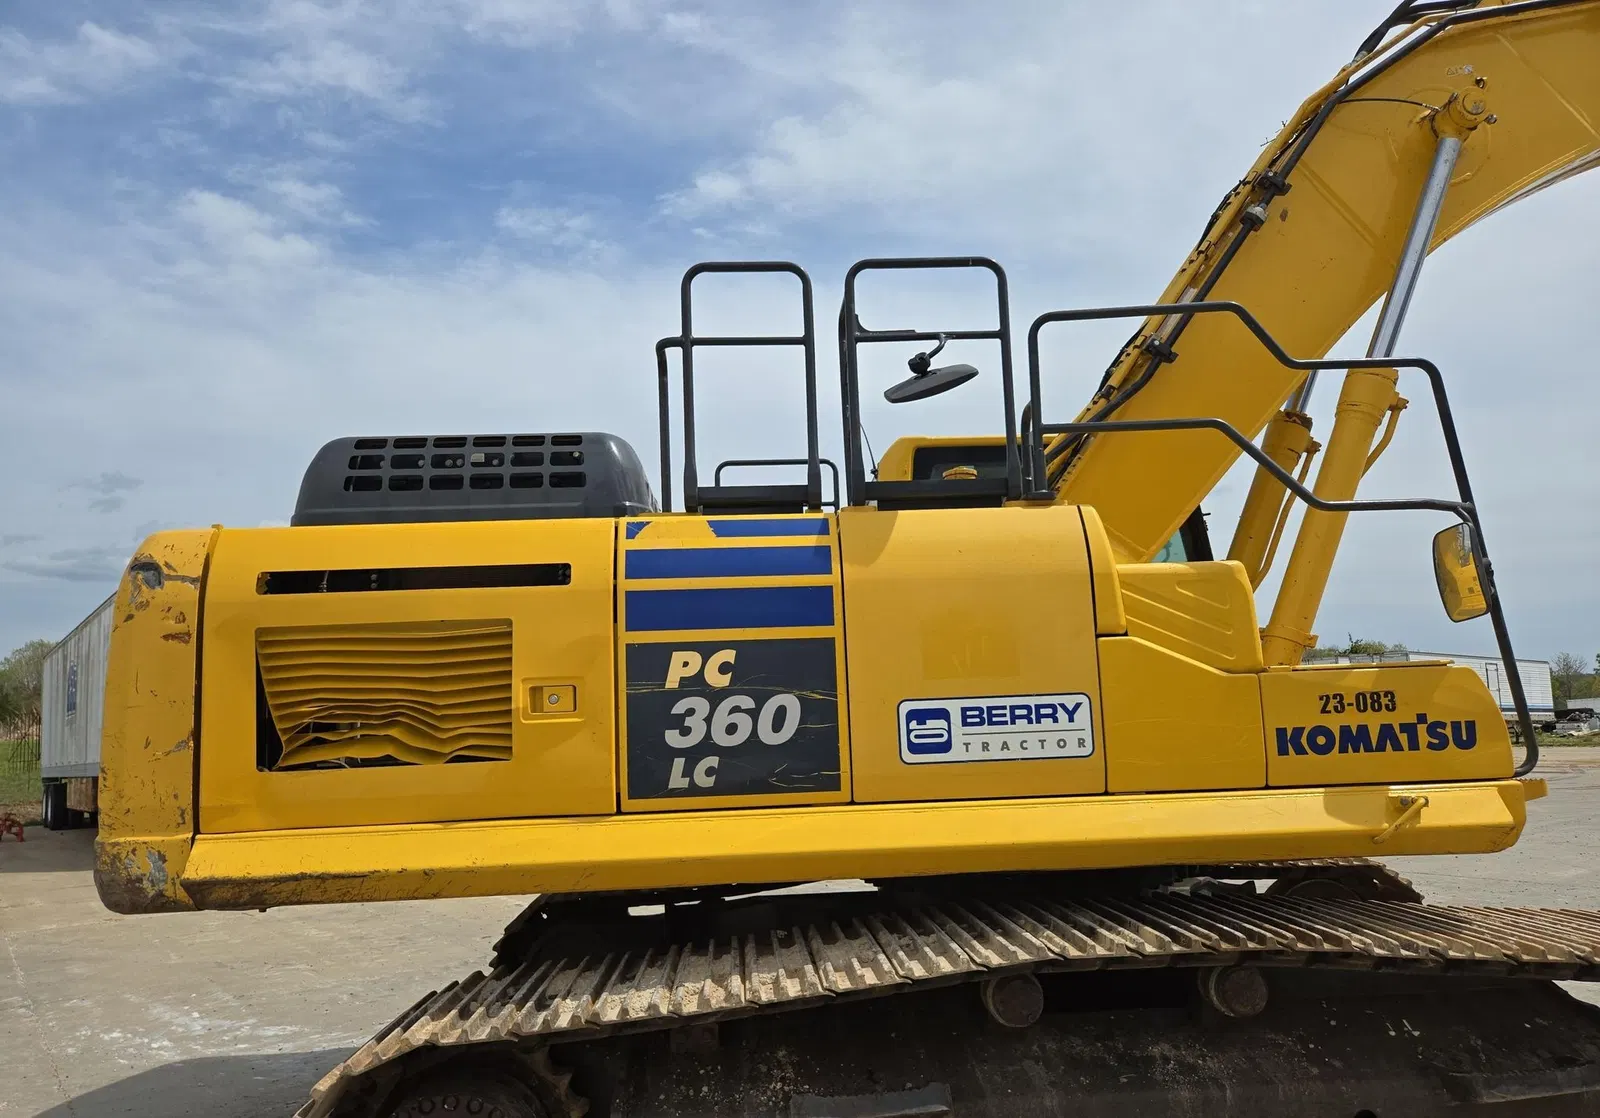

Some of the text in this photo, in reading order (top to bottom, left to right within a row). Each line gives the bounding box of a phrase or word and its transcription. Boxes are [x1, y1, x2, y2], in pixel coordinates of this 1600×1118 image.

[665, 649, 736, 689] PC
[960, 702, 1083, 727] BERRY
[1319, 690, 1397, 714] 23-083
[664, 693, 801, 749] 360
[1275, 713, 1477, 756] KOMATSU
[963, 738, 1086, 753] TRACTOR
[668, 756, 720, 789] LC
